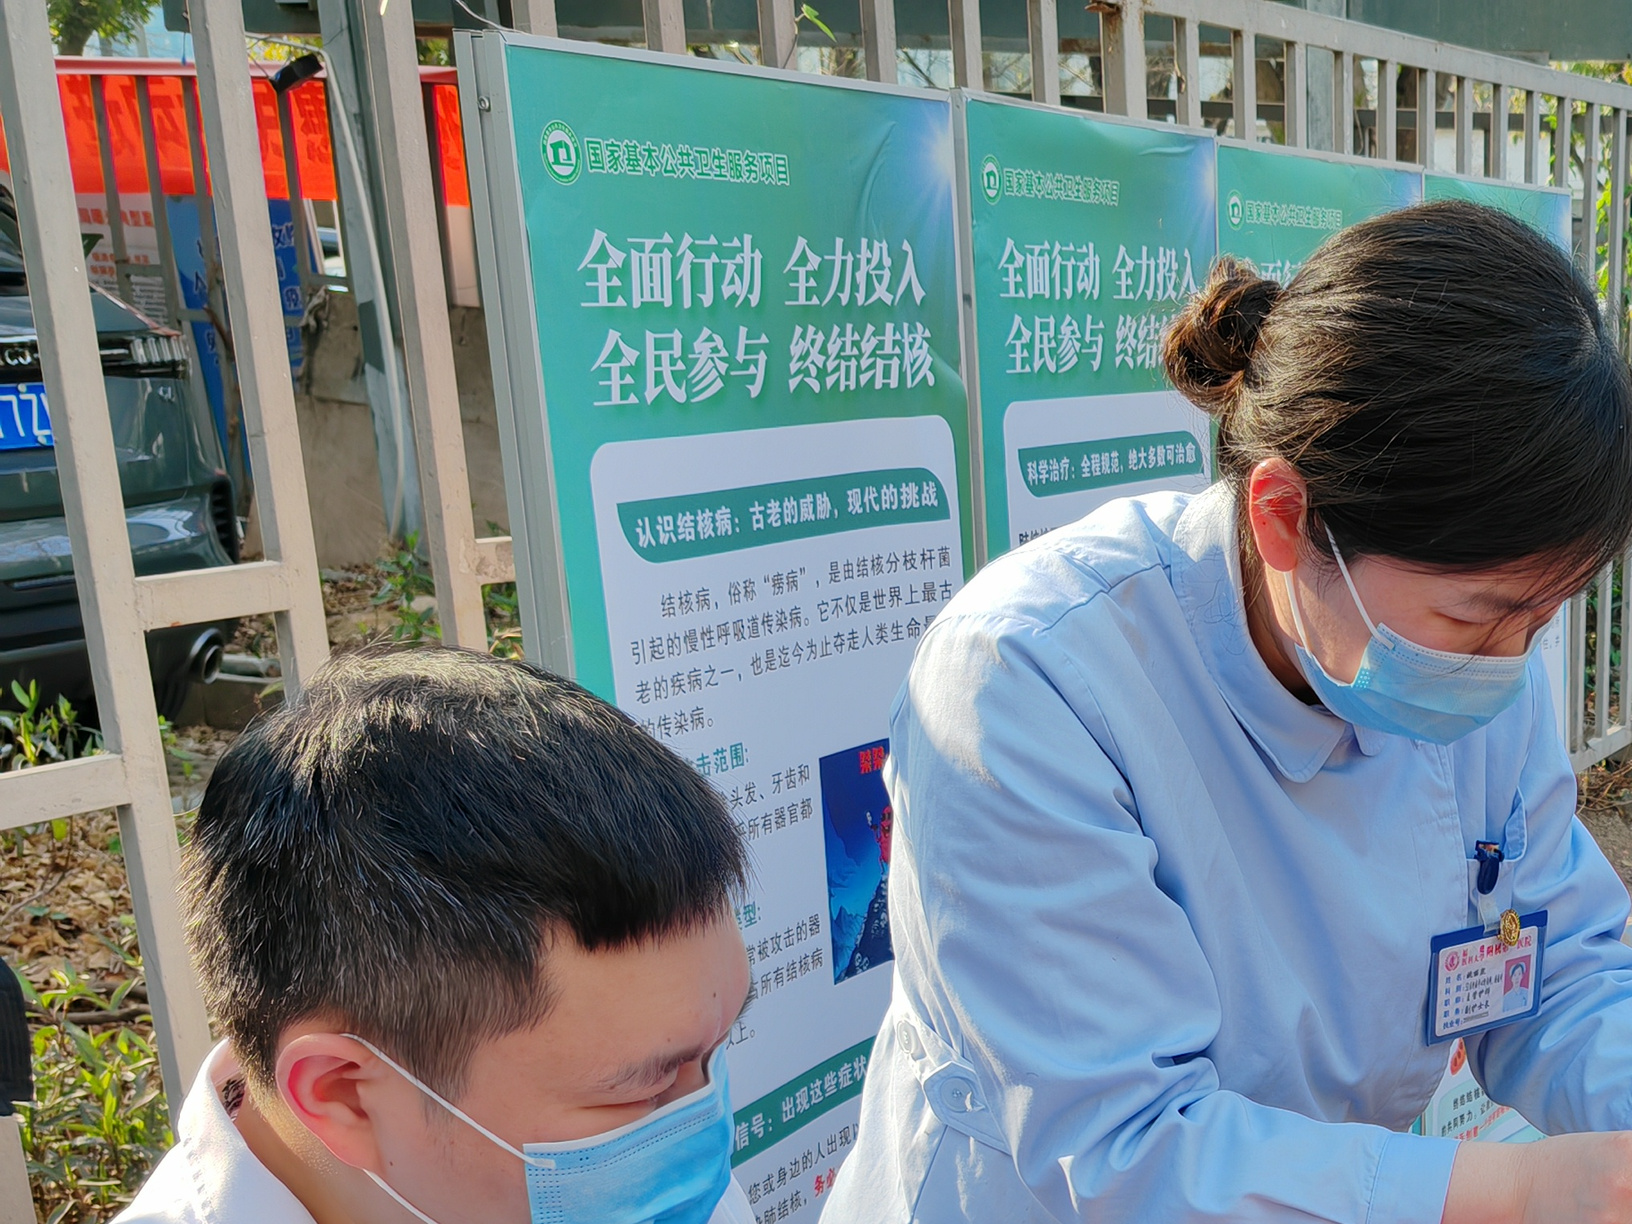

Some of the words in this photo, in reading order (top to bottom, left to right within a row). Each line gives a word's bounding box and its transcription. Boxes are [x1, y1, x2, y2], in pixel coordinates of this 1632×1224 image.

[584, 138, 790, 187] 国家基本公共卫生服务项目
[1003, 167, 1119, 207] 国家基本公共卫生服务项目
[578, 228, 763, 309] 全面行动
[783, 236, 926, 307] 全力投入
[998, 237, 1100, 300] 全面行动
[1112, 244, 1199, 301] 全力投入
[590, 326, 769, 407] 全民参与
[788, 321, 936, 394] 终结结核
[1005, 313, 1105, 374] 全民参与
[1116, 314, 1170, 370] 终结
[1027, 443, 1196, 486] 科学治疗：全程规范，绝大多数可治愈
[635, 481, 939, 549] 认识结核病：古老的威胁，现代的挑战
[660, 546, 951, 619] 结核病，俗称“痨病”，是由结核分枝杆菌
[630, 580, 953, 665] 引起的慢性呼吸道传染病。它不仅是世界上最古
[696, 742, 749, 776] 击范围：
[722, 764, 810, 810] 头发、牙齿和
